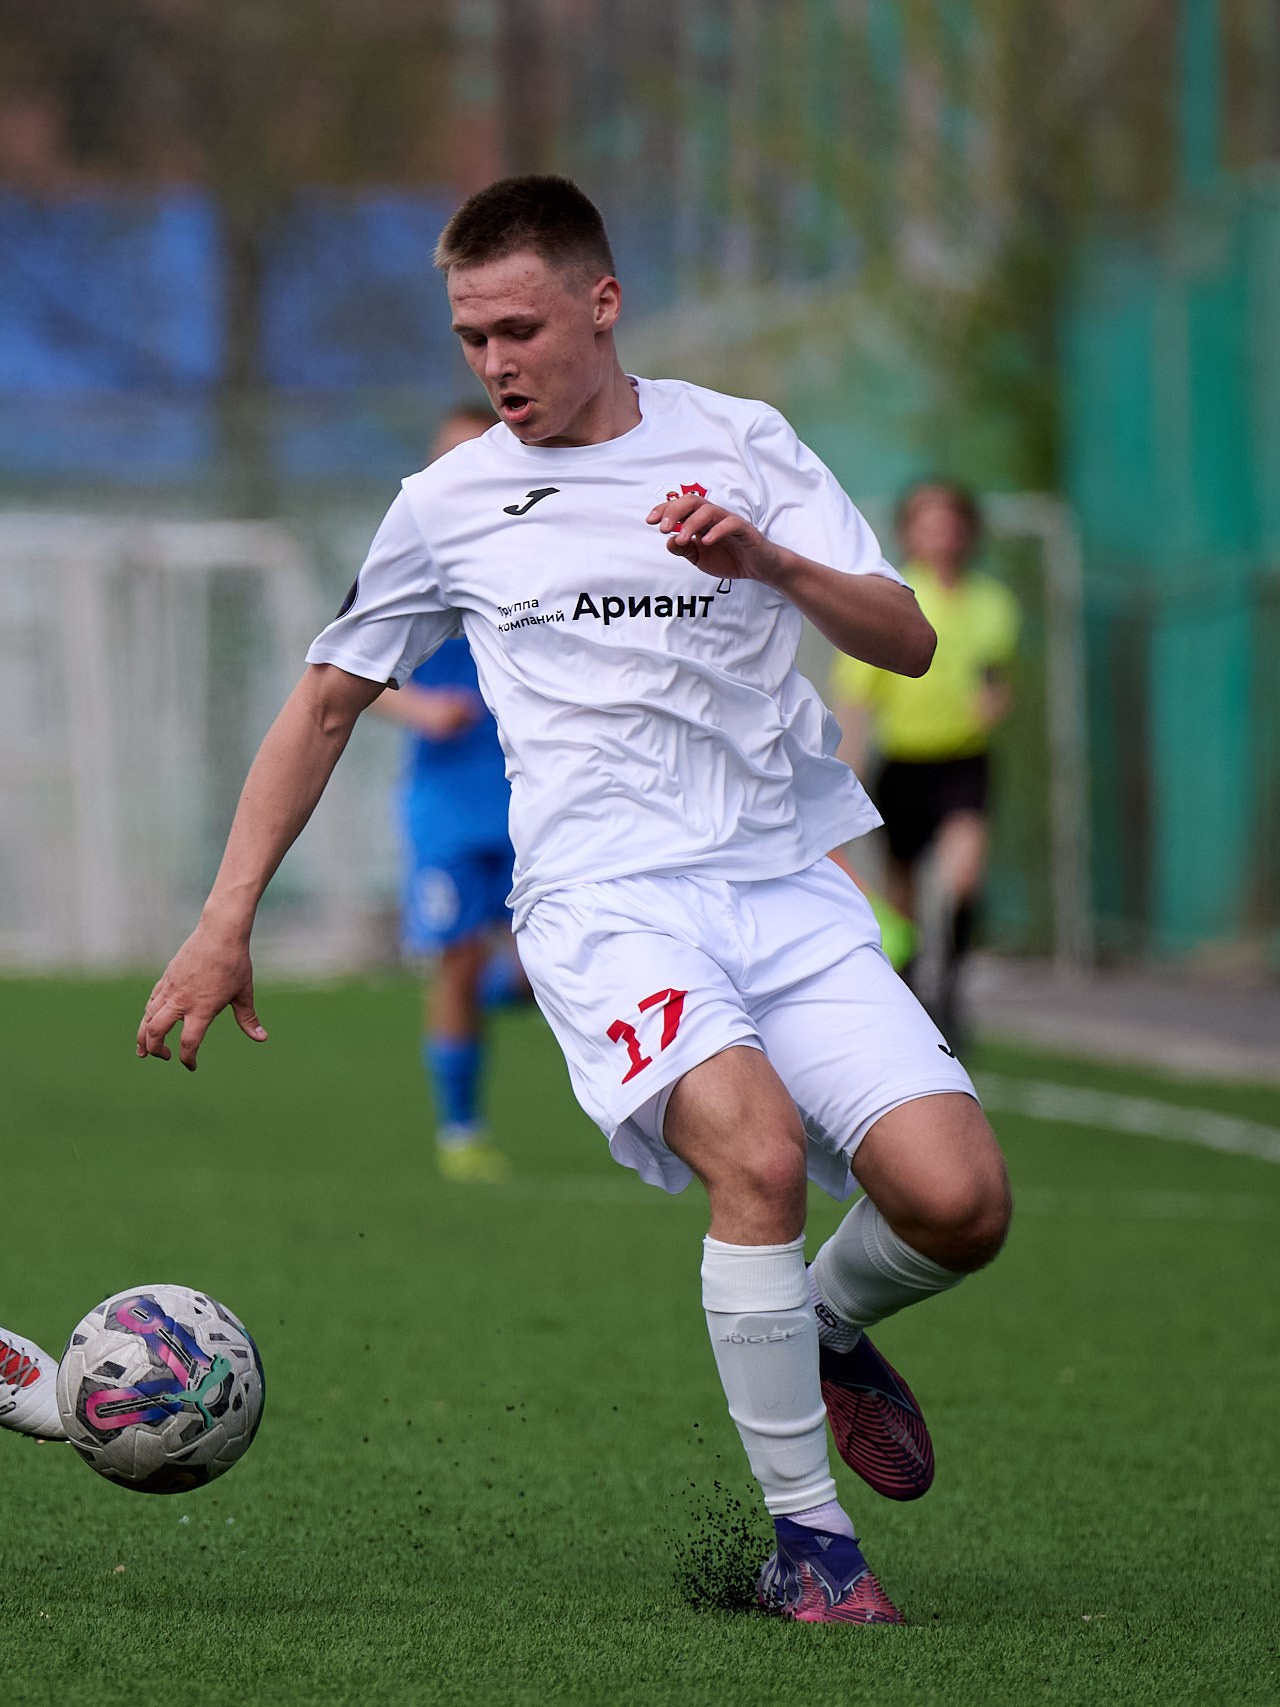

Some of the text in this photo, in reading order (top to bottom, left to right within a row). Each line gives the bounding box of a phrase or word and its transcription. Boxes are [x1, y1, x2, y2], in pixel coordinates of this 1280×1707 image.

[498, 599, 539, 617] Группа
[498, 610, 565, 632] компаний
[572, 592, 715, 625] Ариант
[606, 988, 689, 1085] 17
